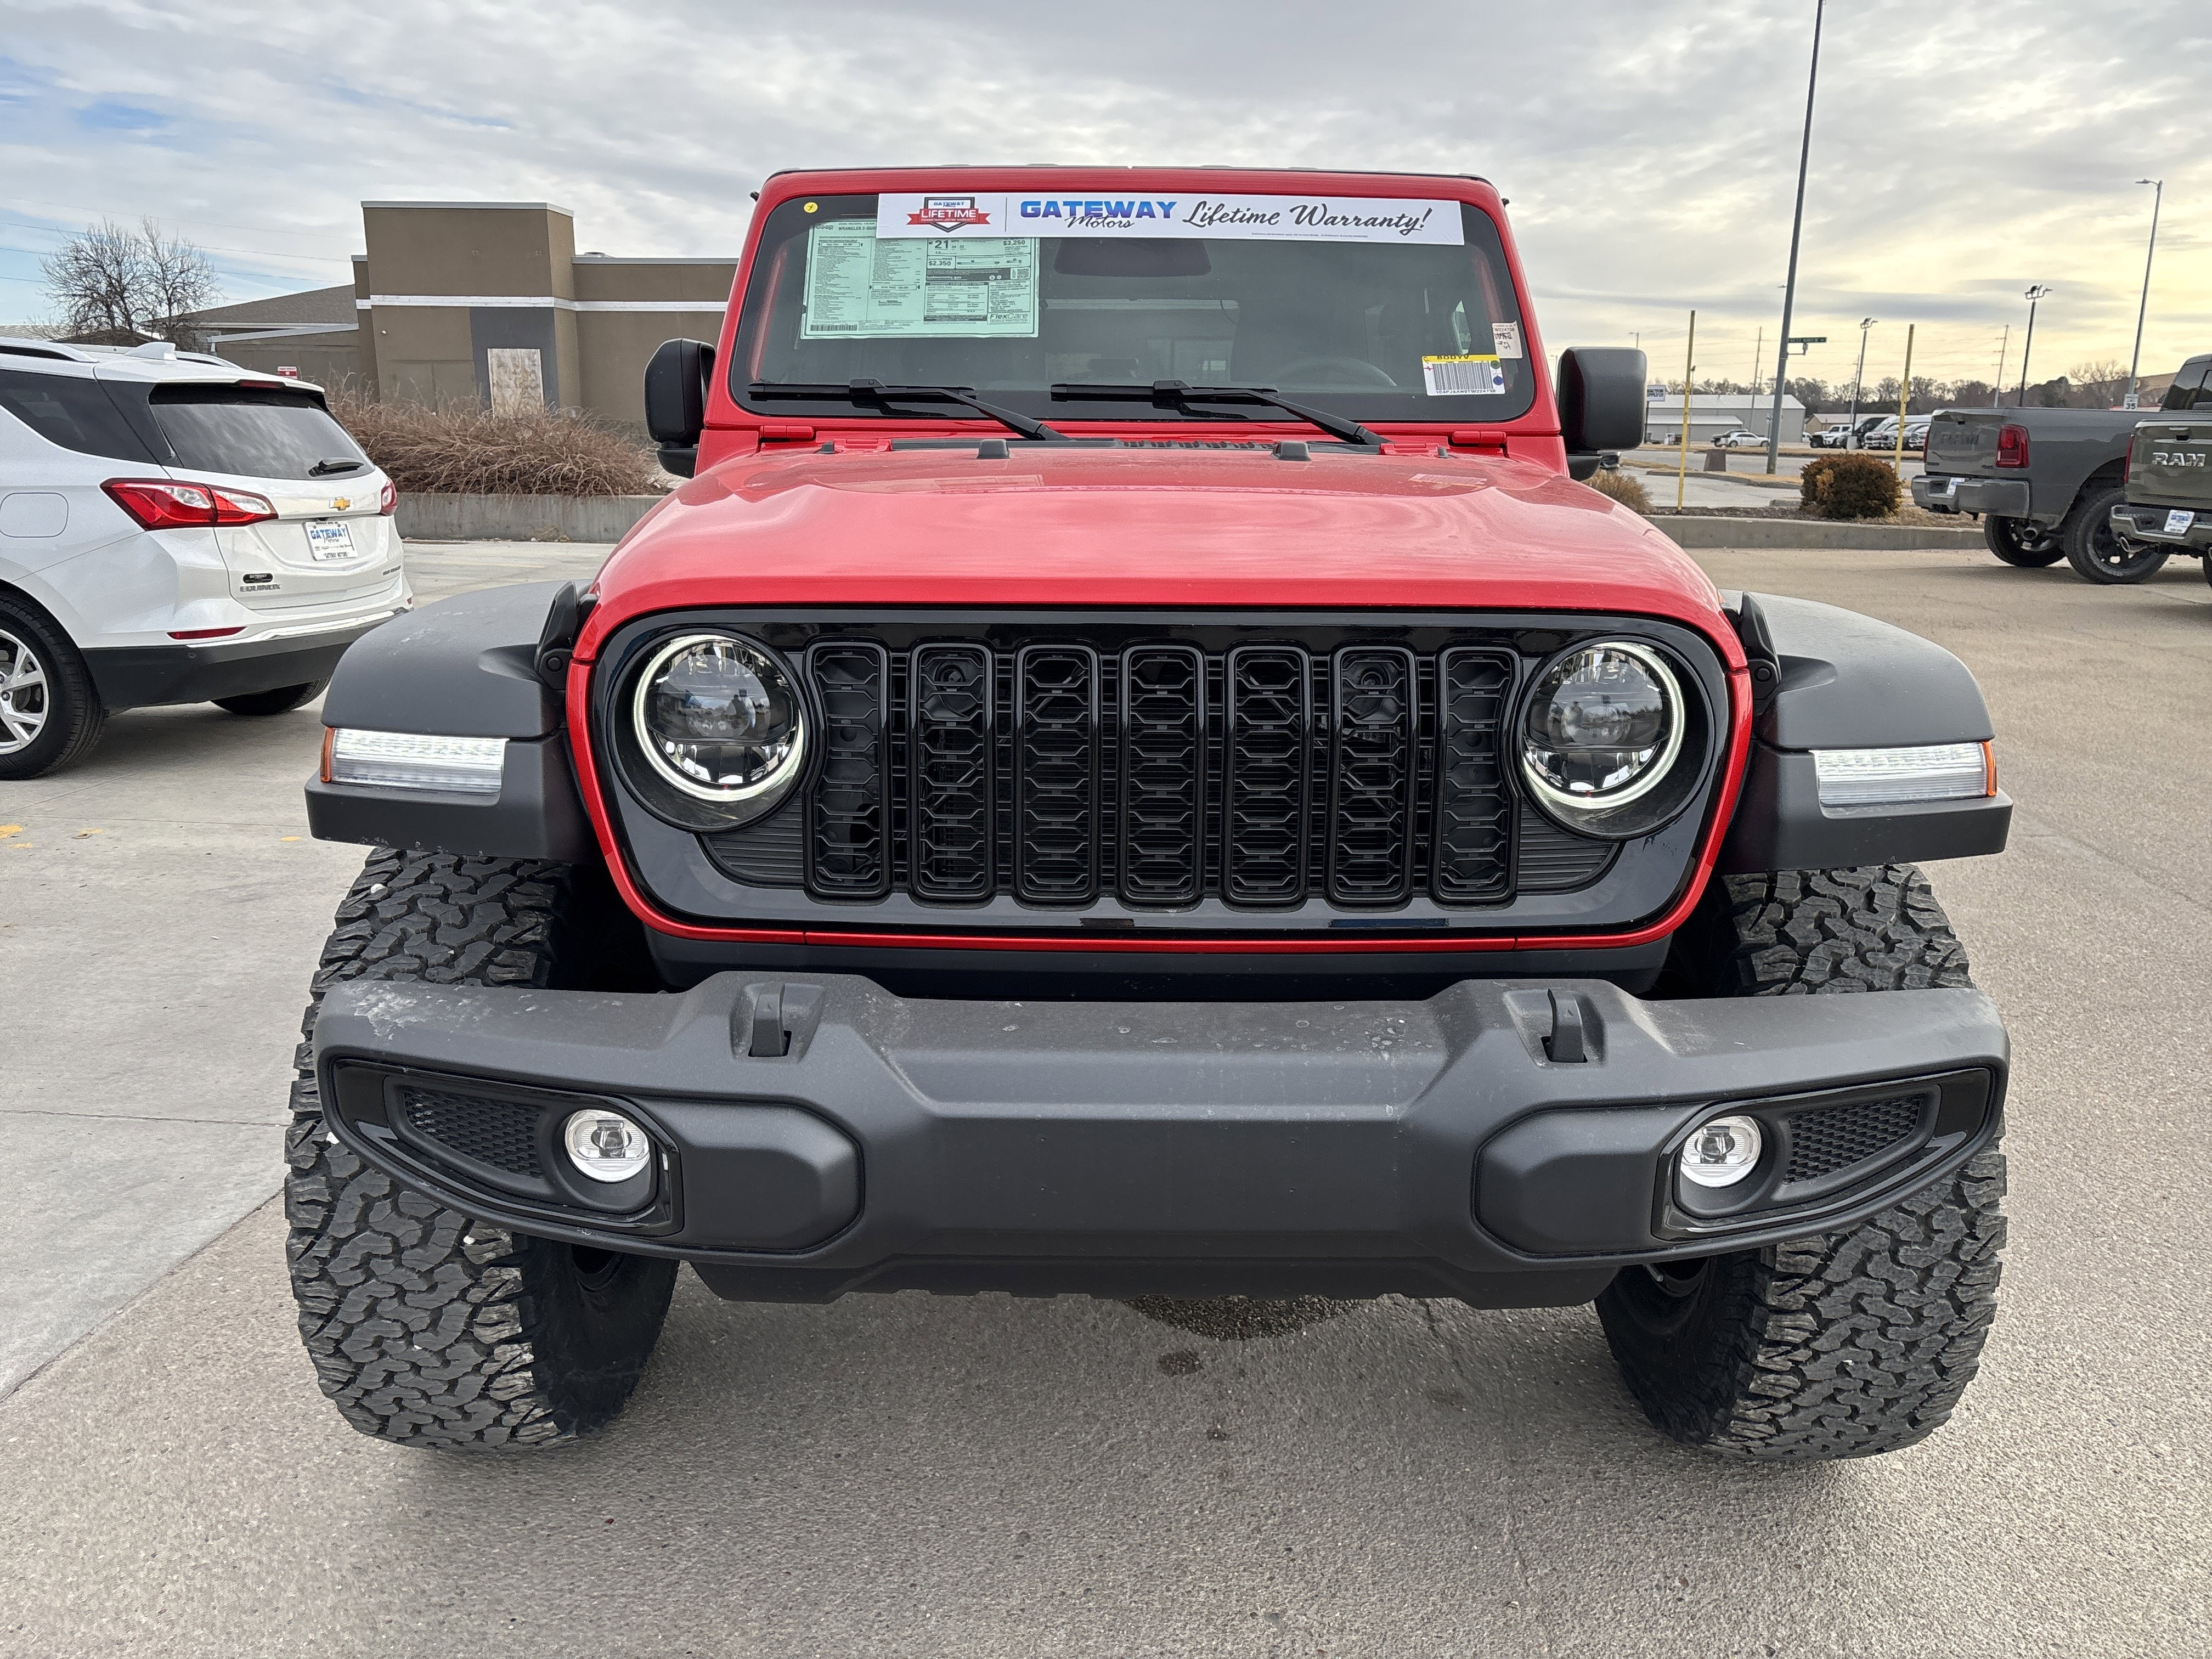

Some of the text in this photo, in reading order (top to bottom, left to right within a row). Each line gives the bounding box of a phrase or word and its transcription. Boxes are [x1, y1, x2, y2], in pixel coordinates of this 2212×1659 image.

[1021, 201, 1177, 218] GATEWAY
[1064, 214, 1135, 228] Motors
[1182, 201, 1433, 236] Lifetime Warranty!
[934, 240, 948, 249] 21
[2152, 453, 2206, 466] RAM
[310, 528, 346, 539] GATEWAY
[240, 584, 281, 592] EQUINOX
